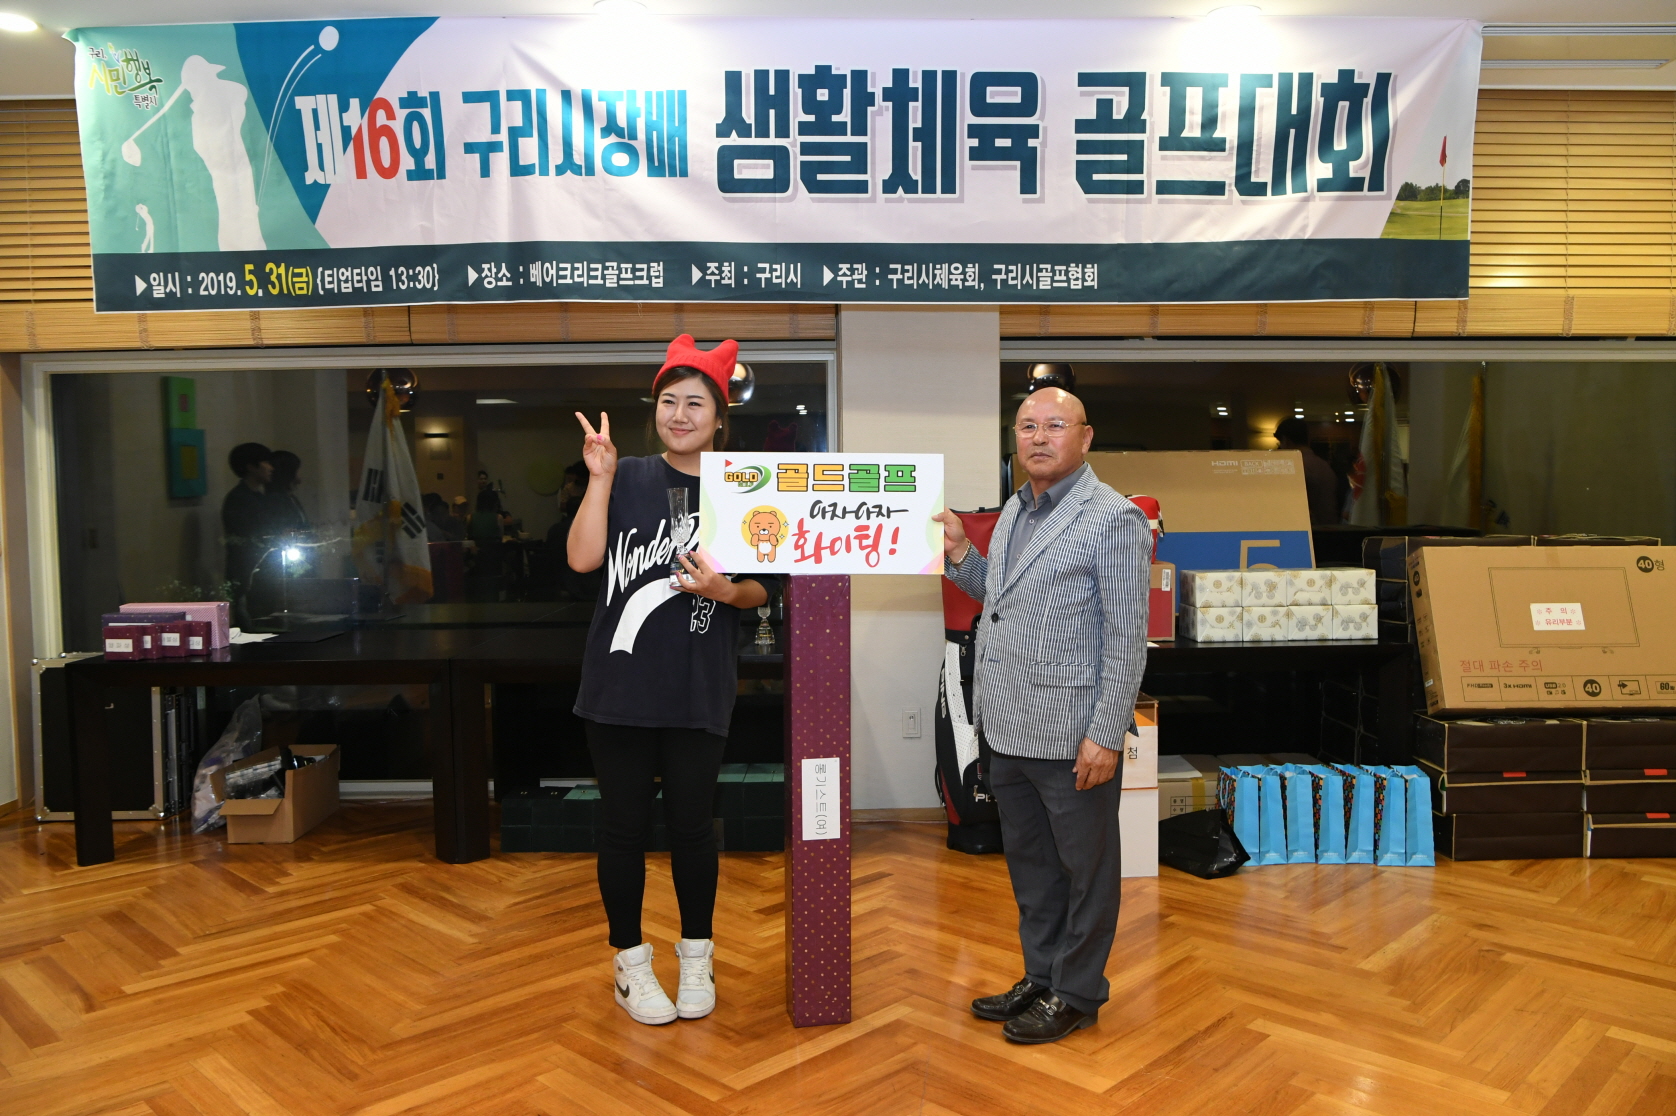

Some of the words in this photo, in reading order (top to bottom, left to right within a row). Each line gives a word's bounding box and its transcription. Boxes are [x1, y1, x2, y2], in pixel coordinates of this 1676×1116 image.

[133, 94, 157, 109] 특별시
[294, 90, 447, 186] 제16회
[461, 88, 690, 179] 구리시장배
[715, 64, 1042, 197] 생활체육
[1074, 68, 1394, 197] 골프대회
[149, 271, 181, 298] 일시
[389, 263, 439, 291] 13:30}
[481, 263, 512, 288] 장소
[529, 261, 665, 288] 베어크리크골프크럽
[704, 262, 735, 288] 주최
[756, 262, 801, 289] 구리시
[836, 262, 868, 289] 주관
[888, 262, 985, 290] 구리시체육회,
[991, 263, 1098, 289] 구리시골프협회
[724, 471, 759, 483] GOLD
[776, 463, 916, 493] 골드골프
[809, 499, 909, 521] 아자아자
[793, 517, 900, 568] 화이팅!
[1545, 618, 1573, 626] 유리부분
[1460, 659, 1485, 673] 절대
[1488, 659, 1514, 673] 파손
[1518, 659, 1543, 673] 주의
[1584, 683, 1600, 693] 40
[1126, 746, 1138, 760] 첨
[814, 762, 829, 837] 롱기스트(여)
